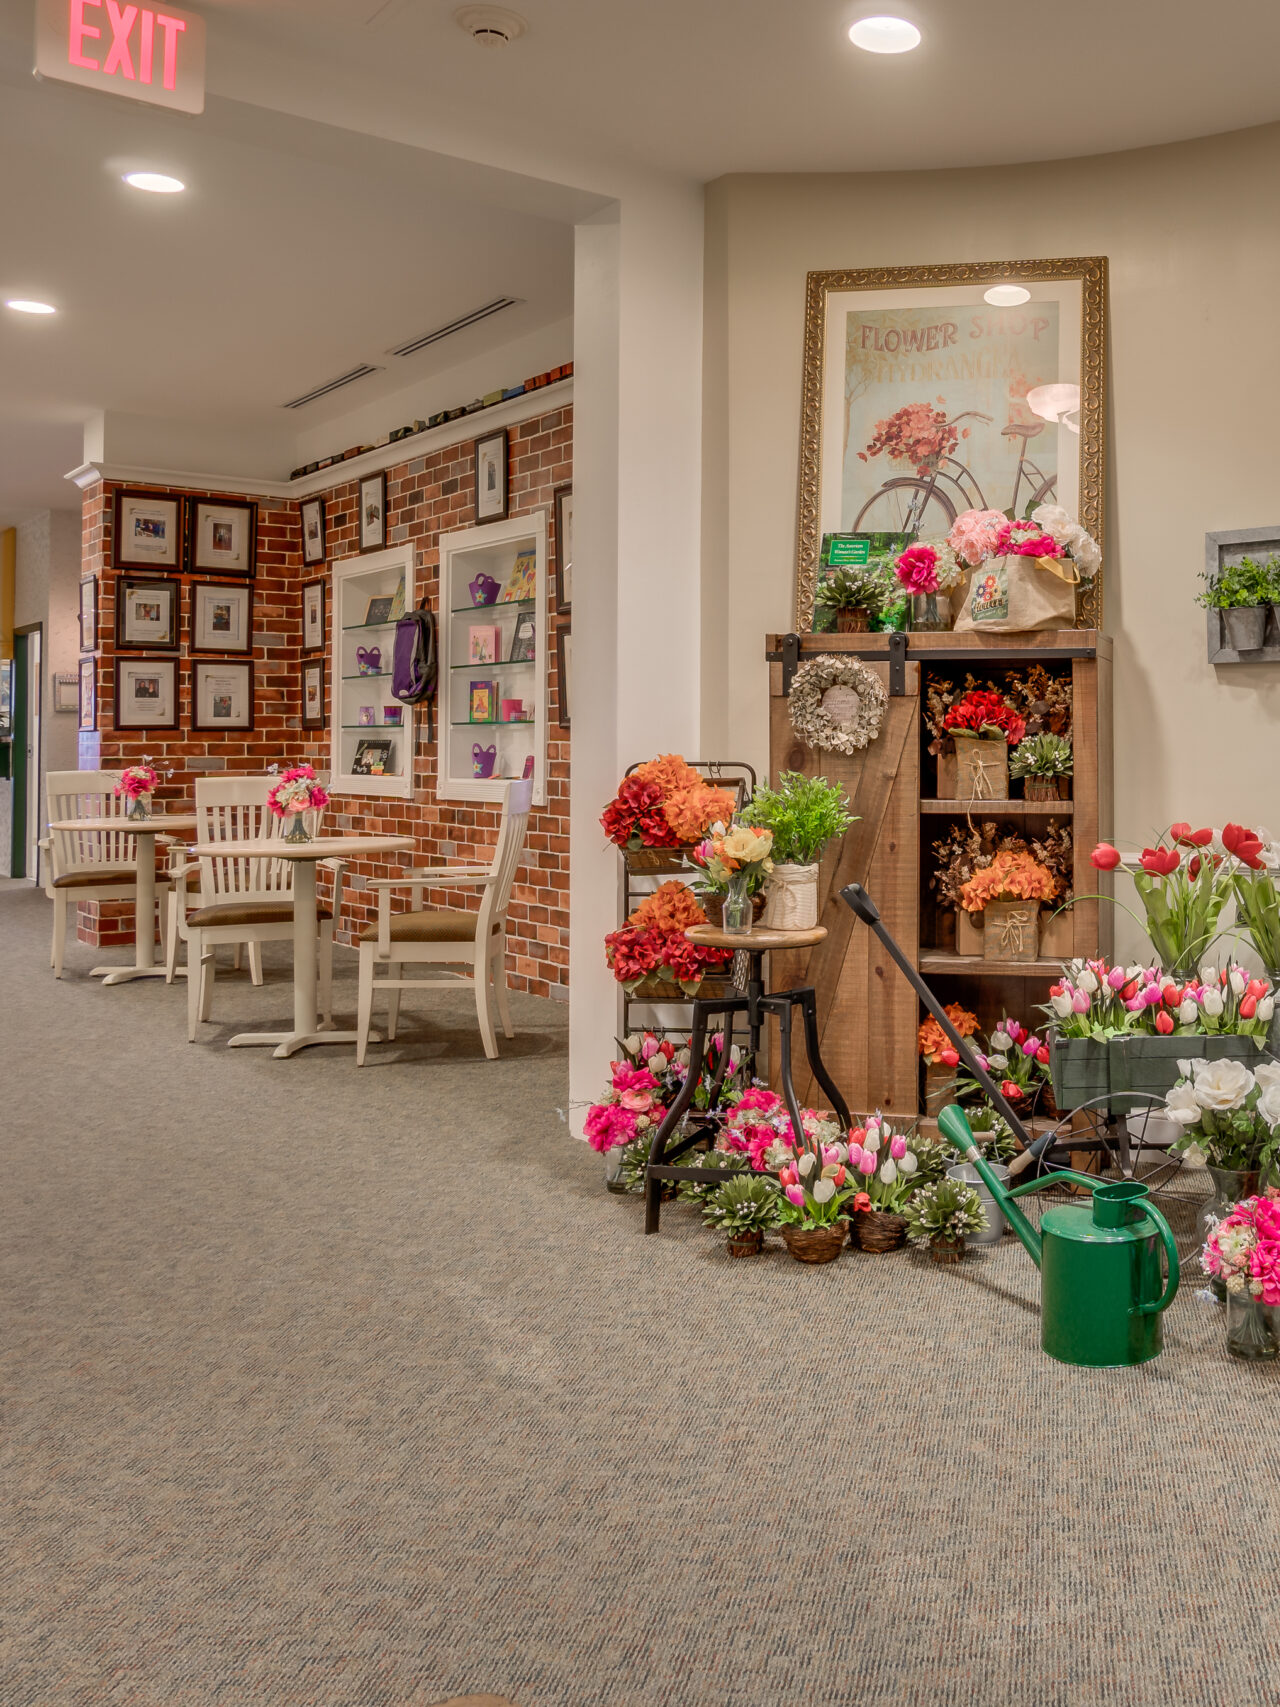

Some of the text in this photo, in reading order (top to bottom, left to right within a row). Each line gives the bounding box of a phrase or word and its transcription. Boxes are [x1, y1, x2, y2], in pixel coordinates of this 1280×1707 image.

[68, 0, 187, 91] EXIT
[861, 312, 1050, 353] FLOWER SHOP
